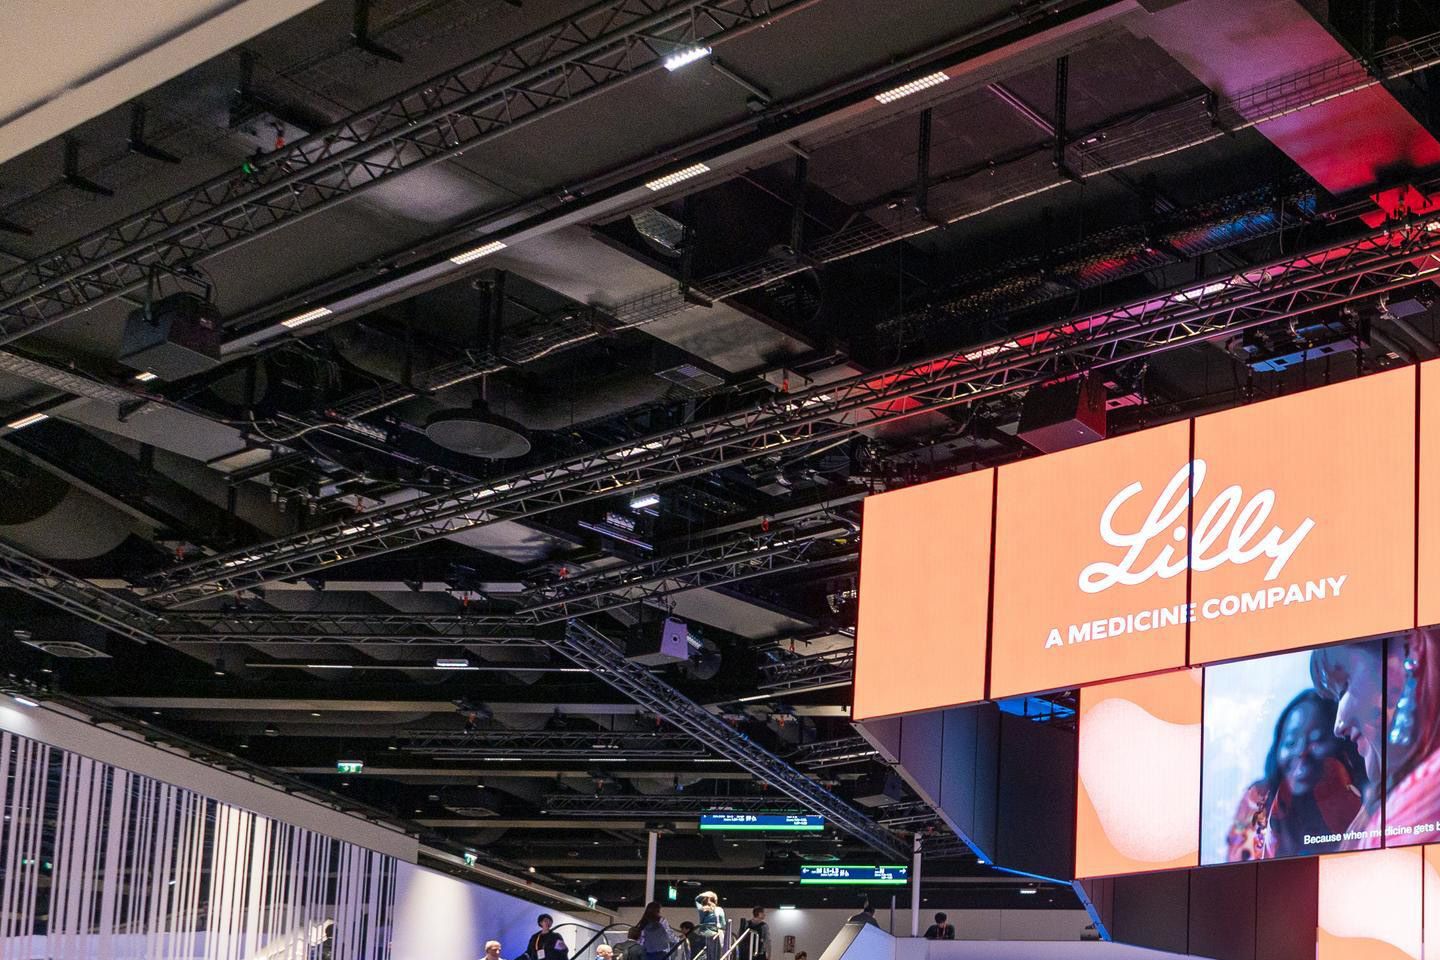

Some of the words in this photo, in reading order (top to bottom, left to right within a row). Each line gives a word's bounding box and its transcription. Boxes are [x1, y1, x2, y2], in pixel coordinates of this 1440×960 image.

[1078, 458, 1316, 593] Lilly
[1044, 628, 1063, 648] A
[1068, 602, 1197, 645] MEDICINE
[1201, 575, 1348, 619] COMPANY
[1303, 833, 1341, 844] Because
[1343, 830, 1368, 840] when
[1414, 824, 1434, 835] gets
